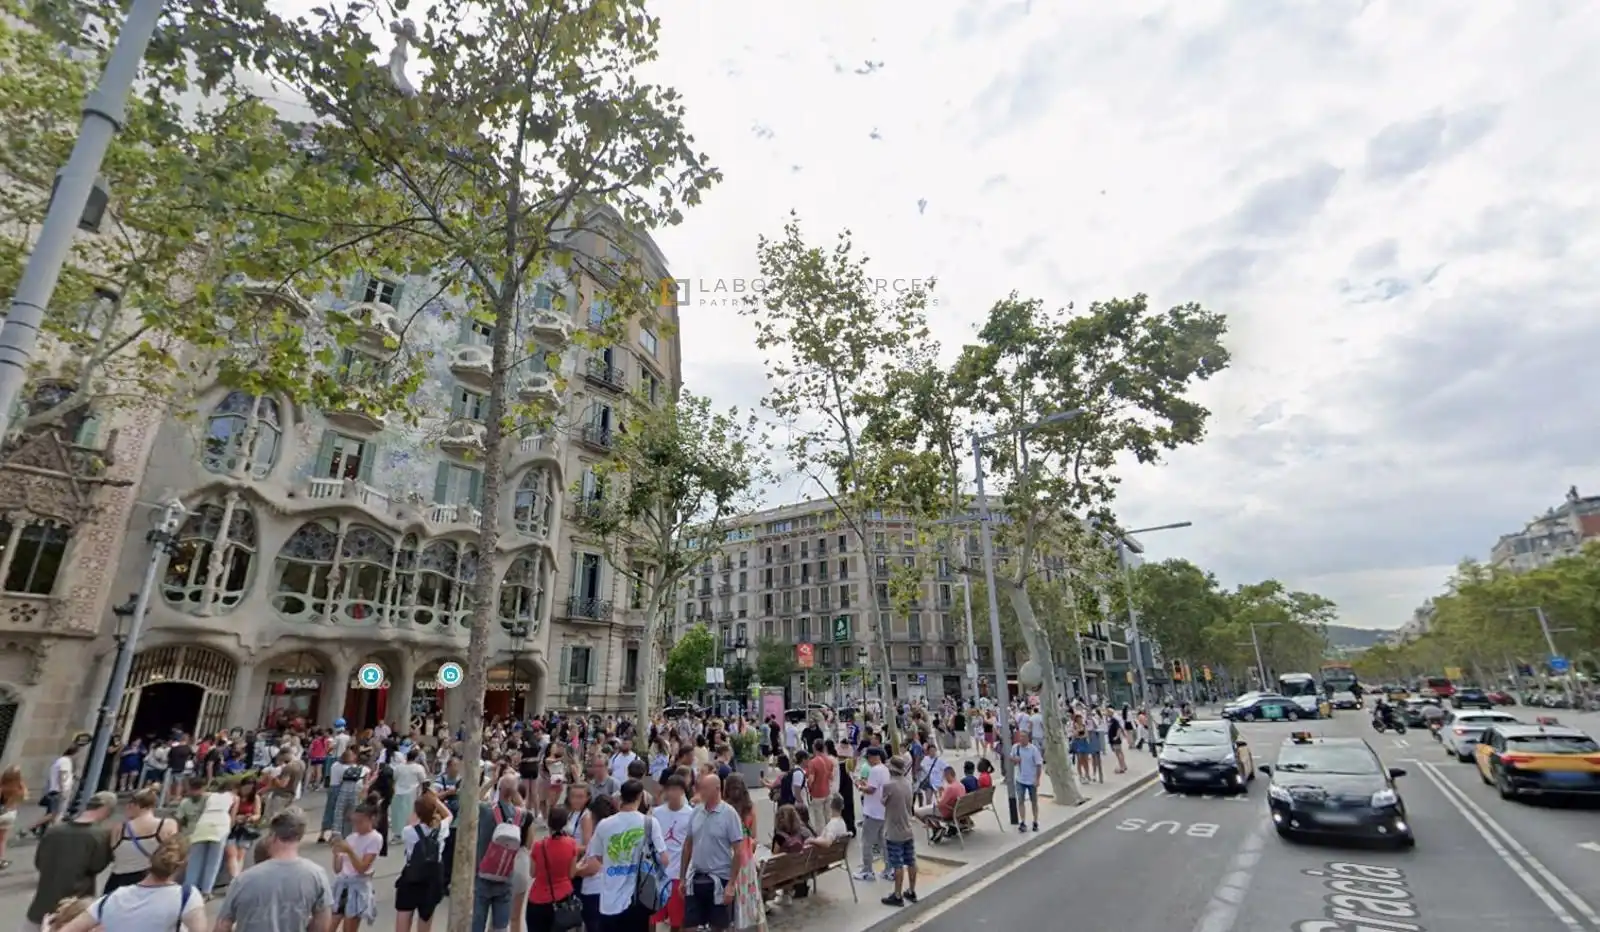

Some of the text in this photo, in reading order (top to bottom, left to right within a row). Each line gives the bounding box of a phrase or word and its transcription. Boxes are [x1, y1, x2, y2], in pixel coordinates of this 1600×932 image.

[285, 678, 319, 689] CASA
[416, 681, 444, 690] GAUD
[1115, 818, 1221, 838] BUS
